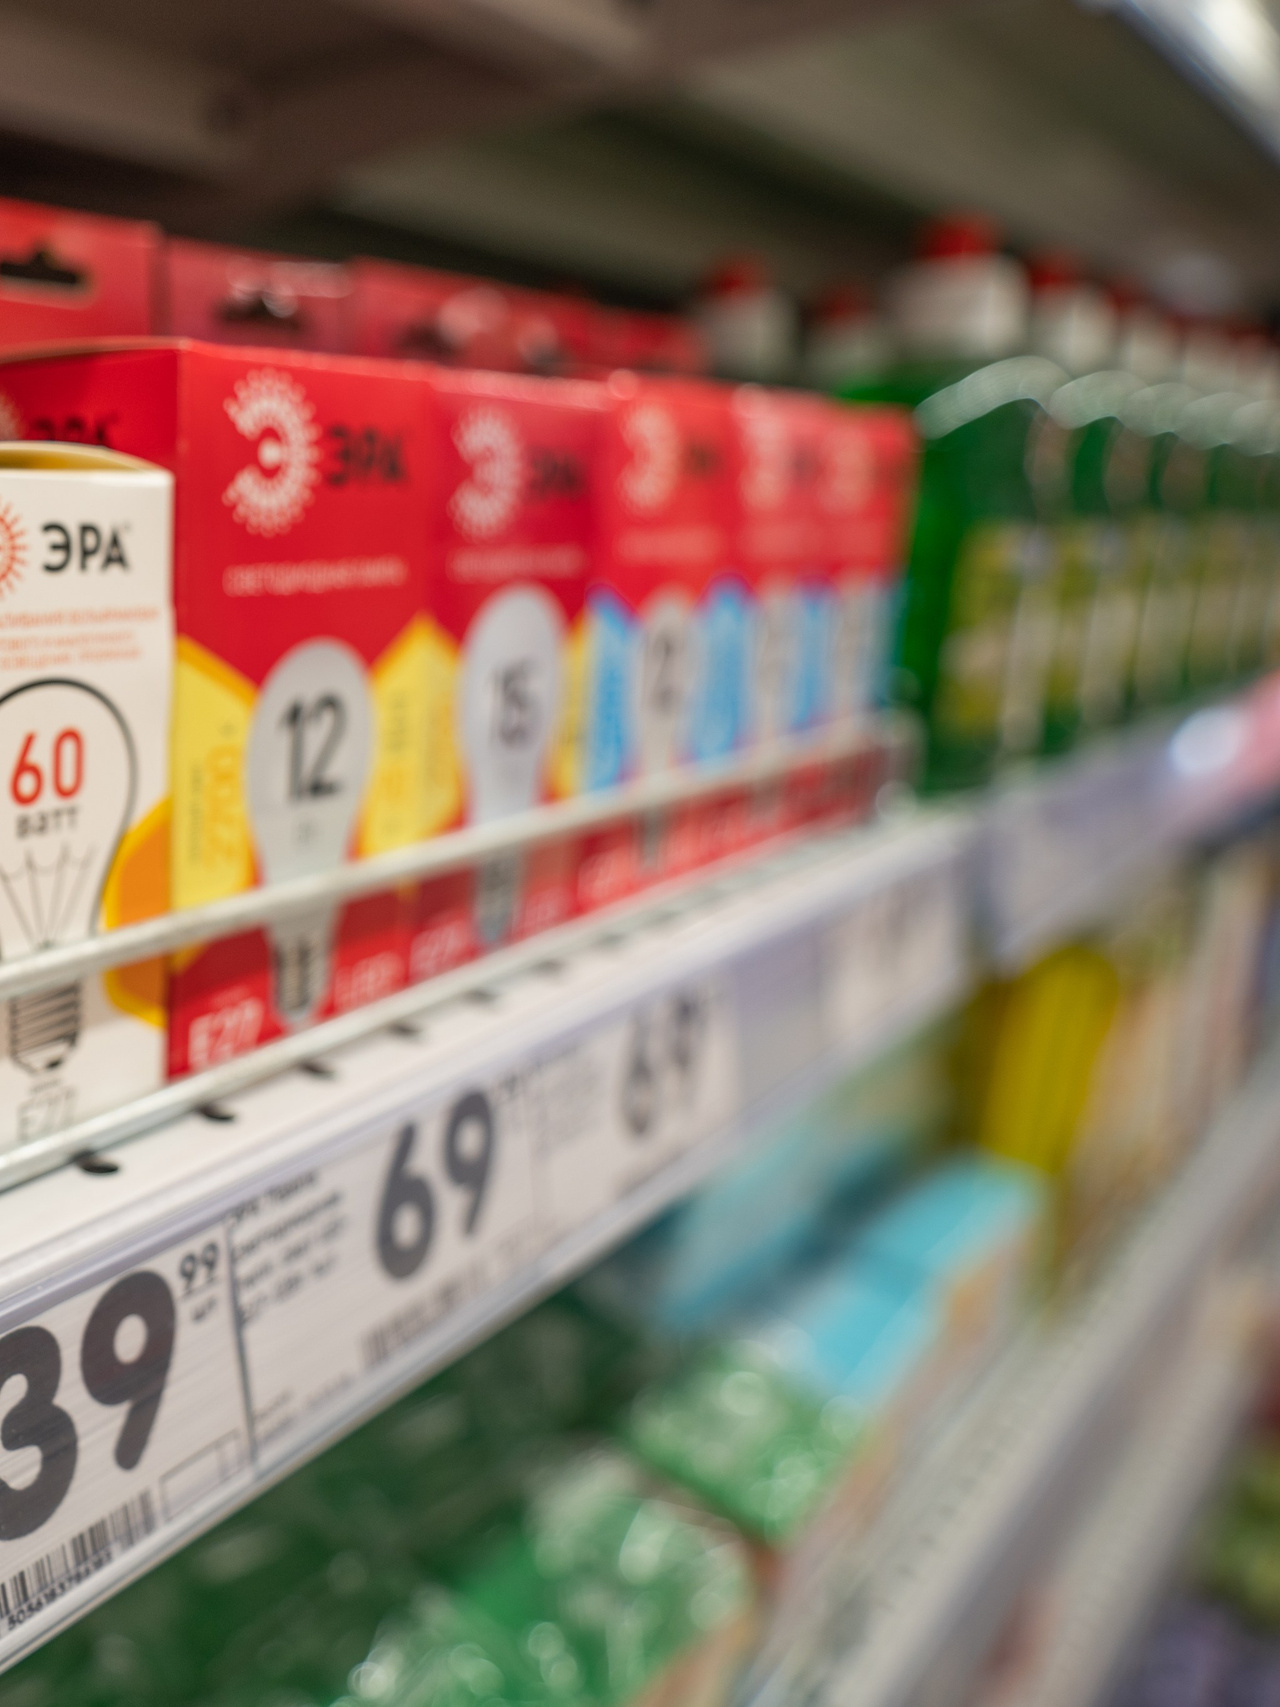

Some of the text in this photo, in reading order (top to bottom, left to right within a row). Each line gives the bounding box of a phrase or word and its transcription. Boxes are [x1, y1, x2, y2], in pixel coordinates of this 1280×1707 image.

[40, 521, 131, 574] ЭРА
[10, 726, 84, 807] 60
[278, 690, 347, 805] 12
[373, 1088, 496, 1280] 69
[179, 1242, 219, 1295] 99
